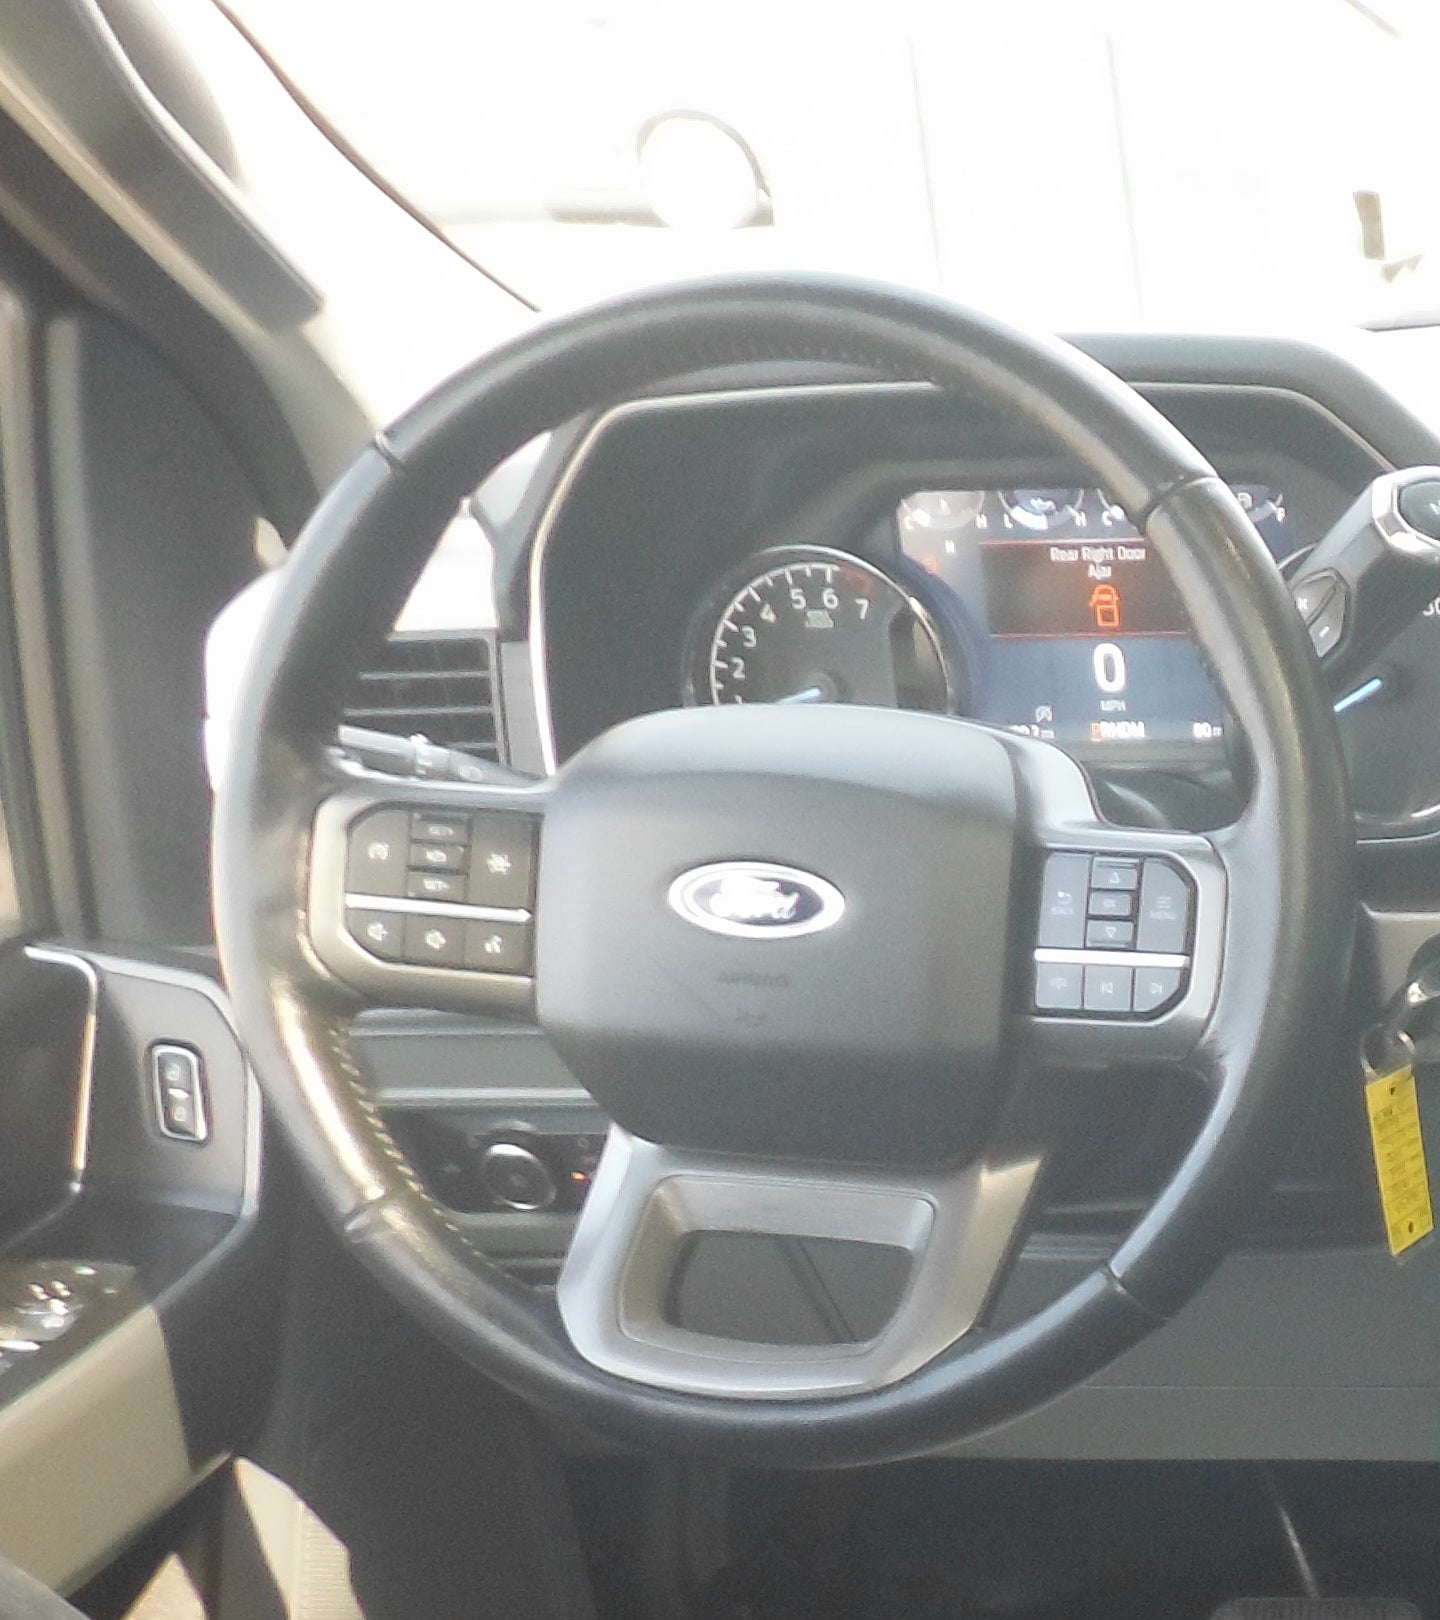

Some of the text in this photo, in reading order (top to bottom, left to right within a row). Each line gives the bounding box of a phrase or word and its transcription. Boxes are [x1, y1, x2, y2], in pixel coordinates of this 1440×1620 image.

[1050, 546, 1146, 564] Rear Right Door
[1088, 563, 1111, 580] Ajar
[790, 588, 806, 610] 5
[822, 588, 839, 610] 6
[855, 598, 869, 620] 7
[760, 604, 777, 623] 4
[741, 626, 757, 648] 3
[731, 657, 746, 680] 2
[1093, 642, 1127, 692] 0
